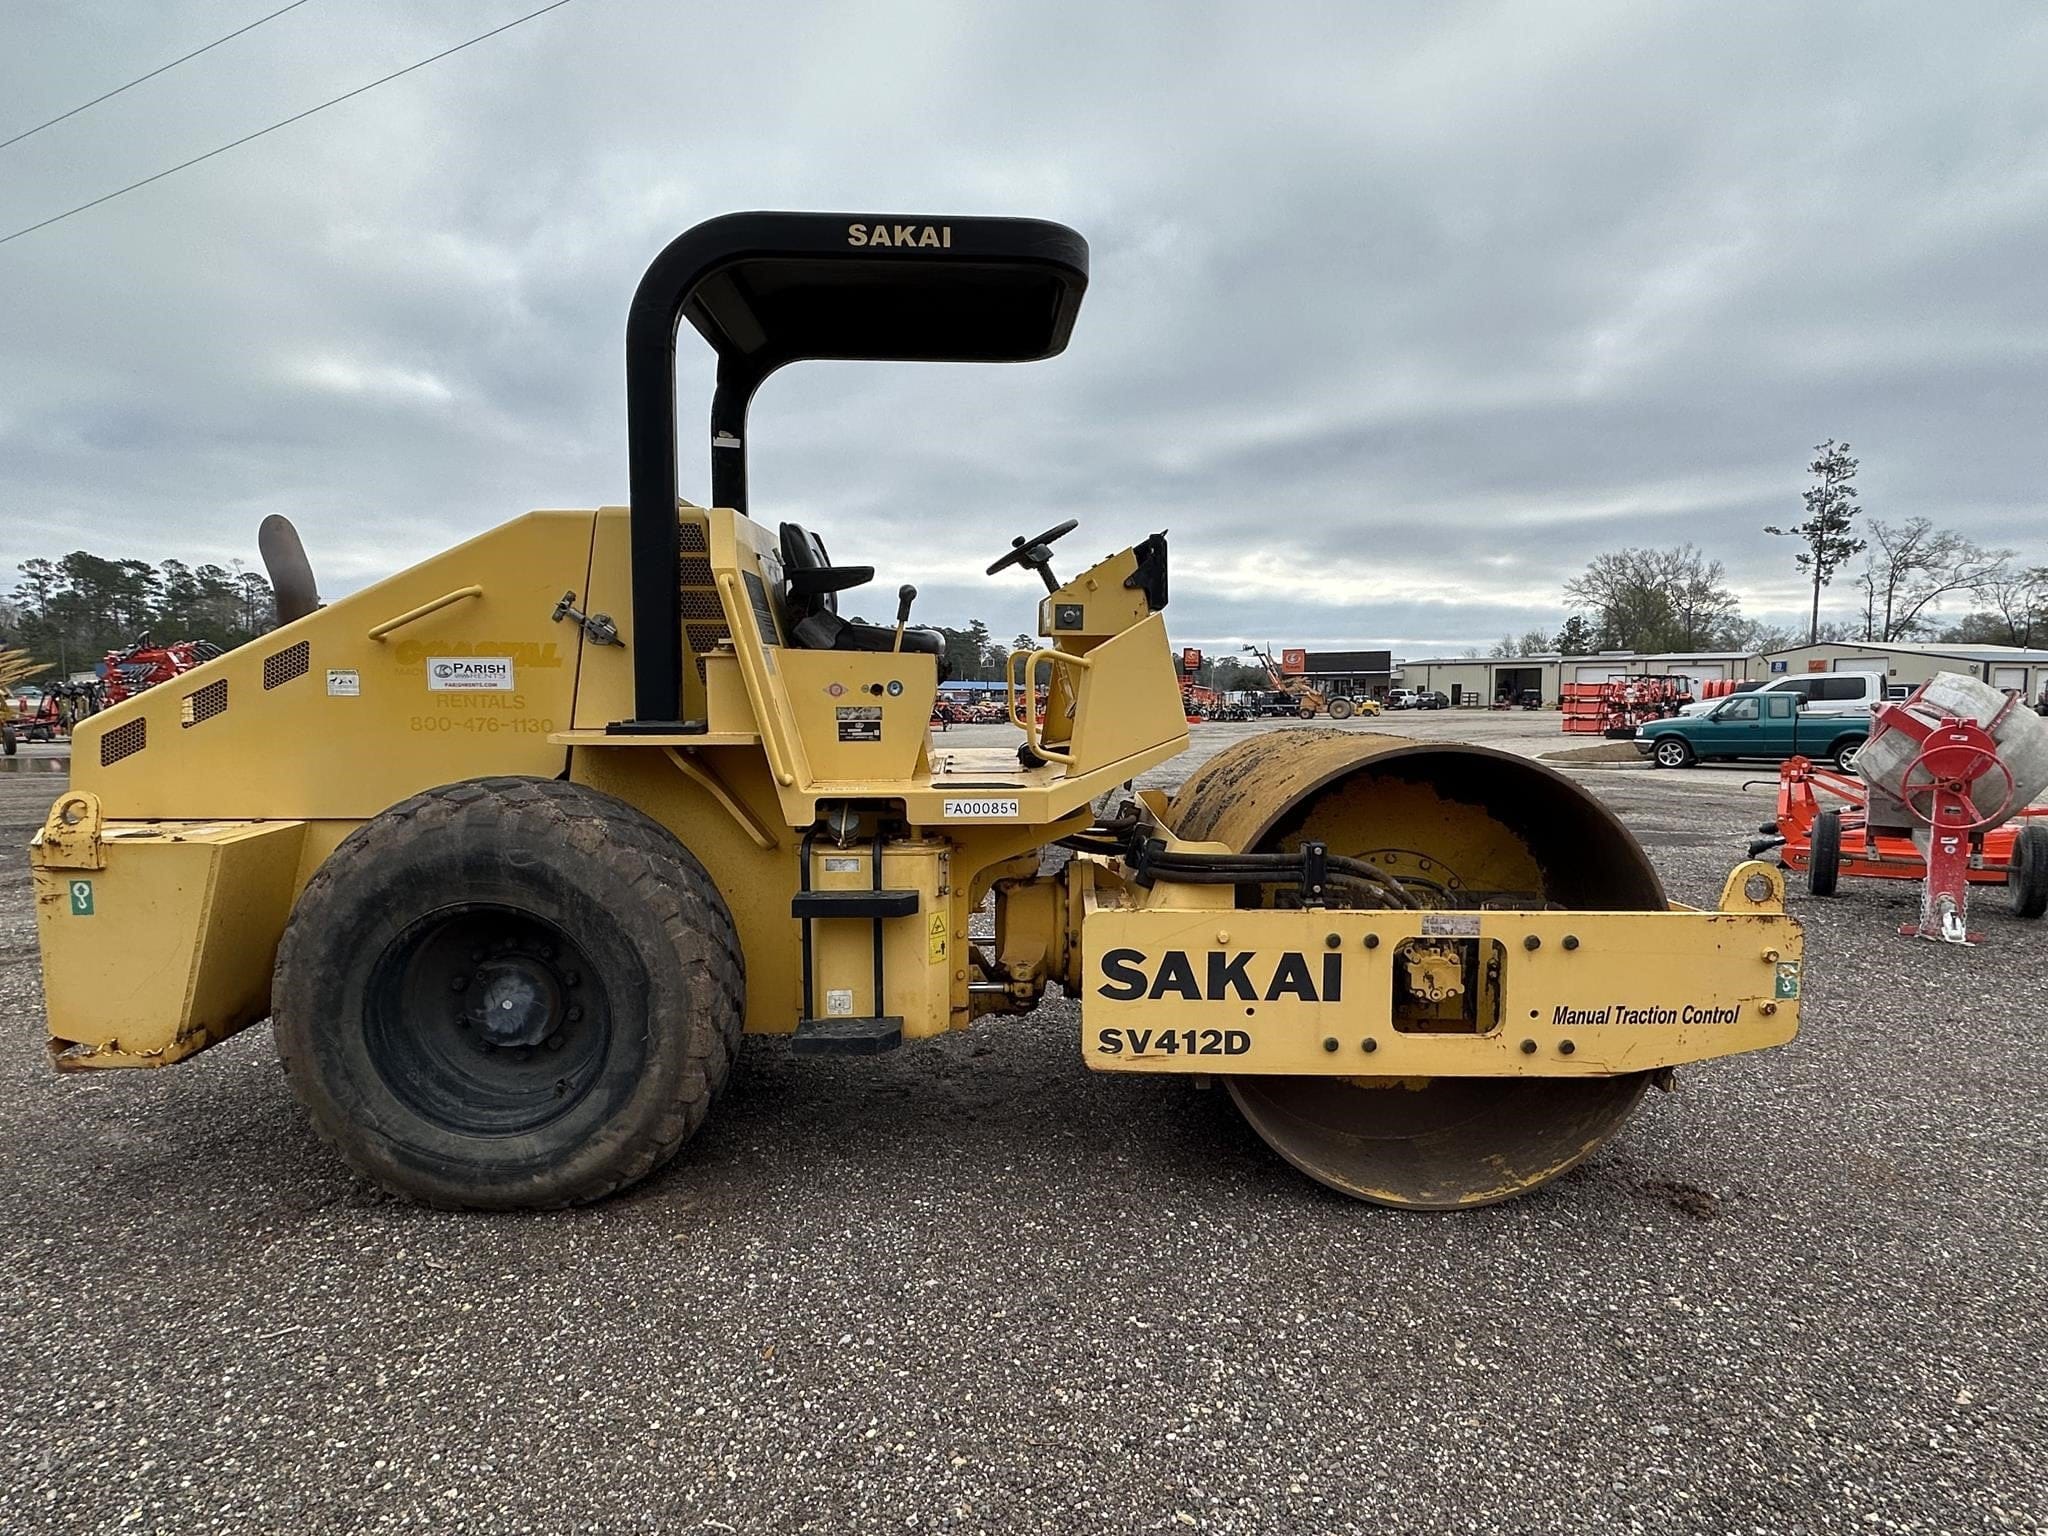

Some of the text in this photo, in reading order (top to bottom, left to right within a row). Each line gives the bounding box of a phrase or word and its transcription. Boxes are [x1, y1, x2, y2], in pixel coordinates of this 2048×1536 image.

[848, 224, 951, 248] SAKAI
[453, 663, 506, 674] PARISH
[436, 694, 526, 709] RENTALS
[410, 716, 554, 733] 800-476-1130
[945, 803, 1017, 814] FA000859
[1097, 948, 1342, 1001] SAKAI
[1553, 1005, 1740, 1024] Manual Traction Control
[1097, 1029, 1251, 1055] SV412D
